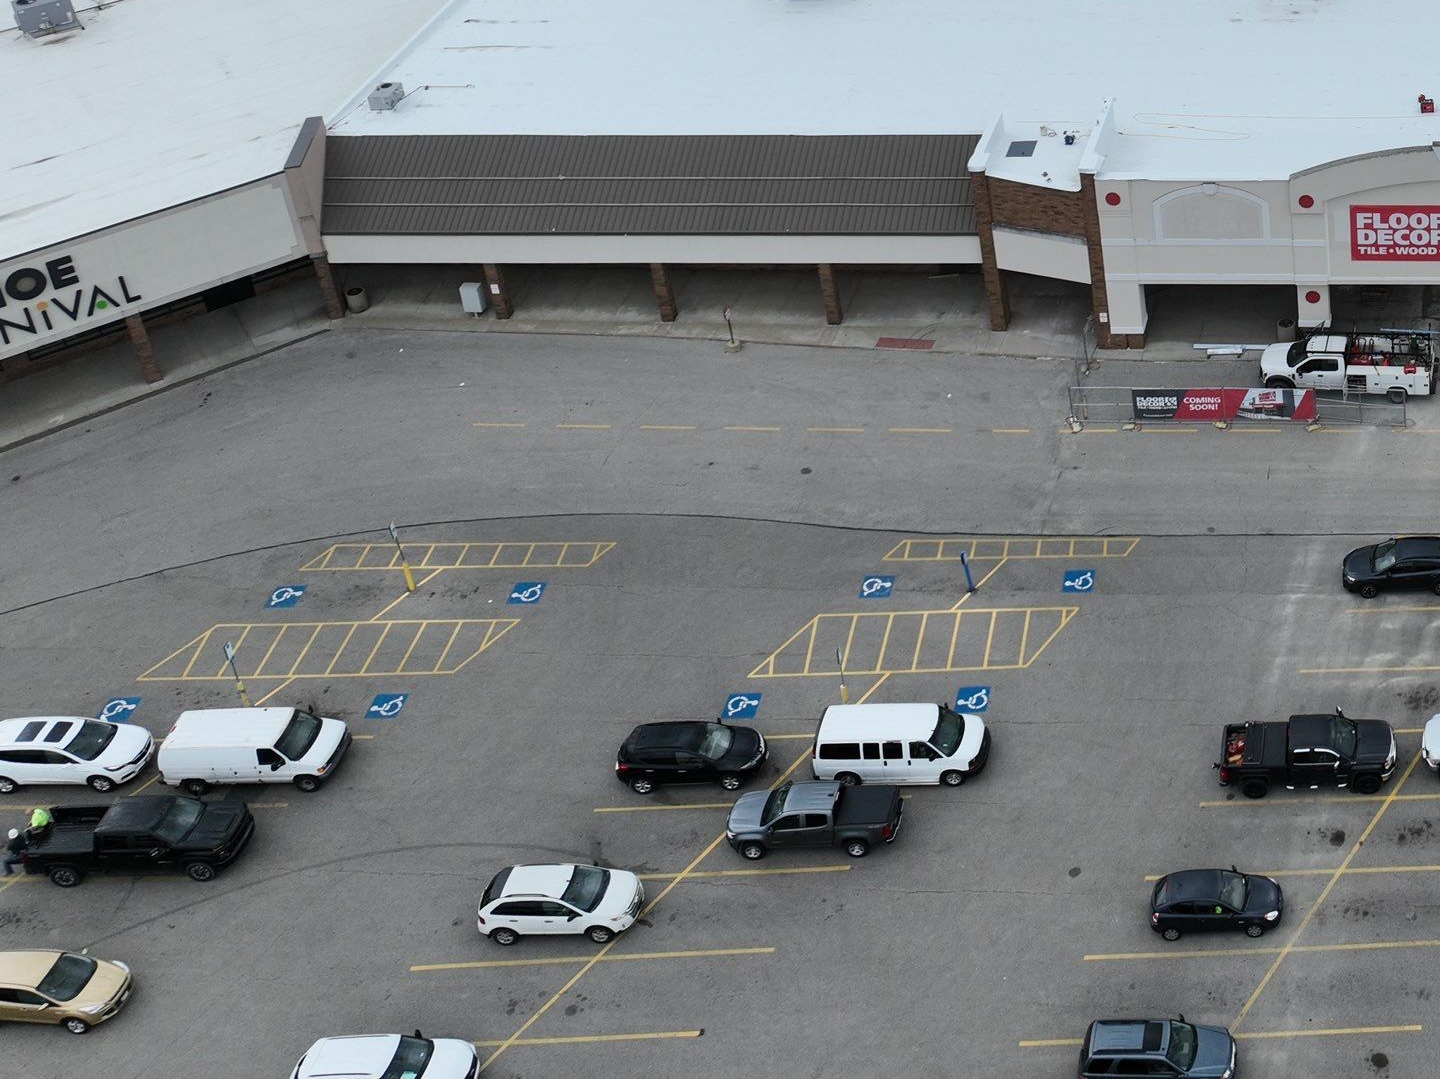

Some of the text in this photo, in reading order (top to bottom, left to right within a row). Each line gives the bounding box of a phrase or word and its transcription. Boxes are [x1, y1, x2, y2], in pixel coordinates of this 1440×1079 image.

[1358, 246, 1388, 255] TILE
[1395, 246, 1438, 255] WOOD
[0, 255, 80, 309] OE
